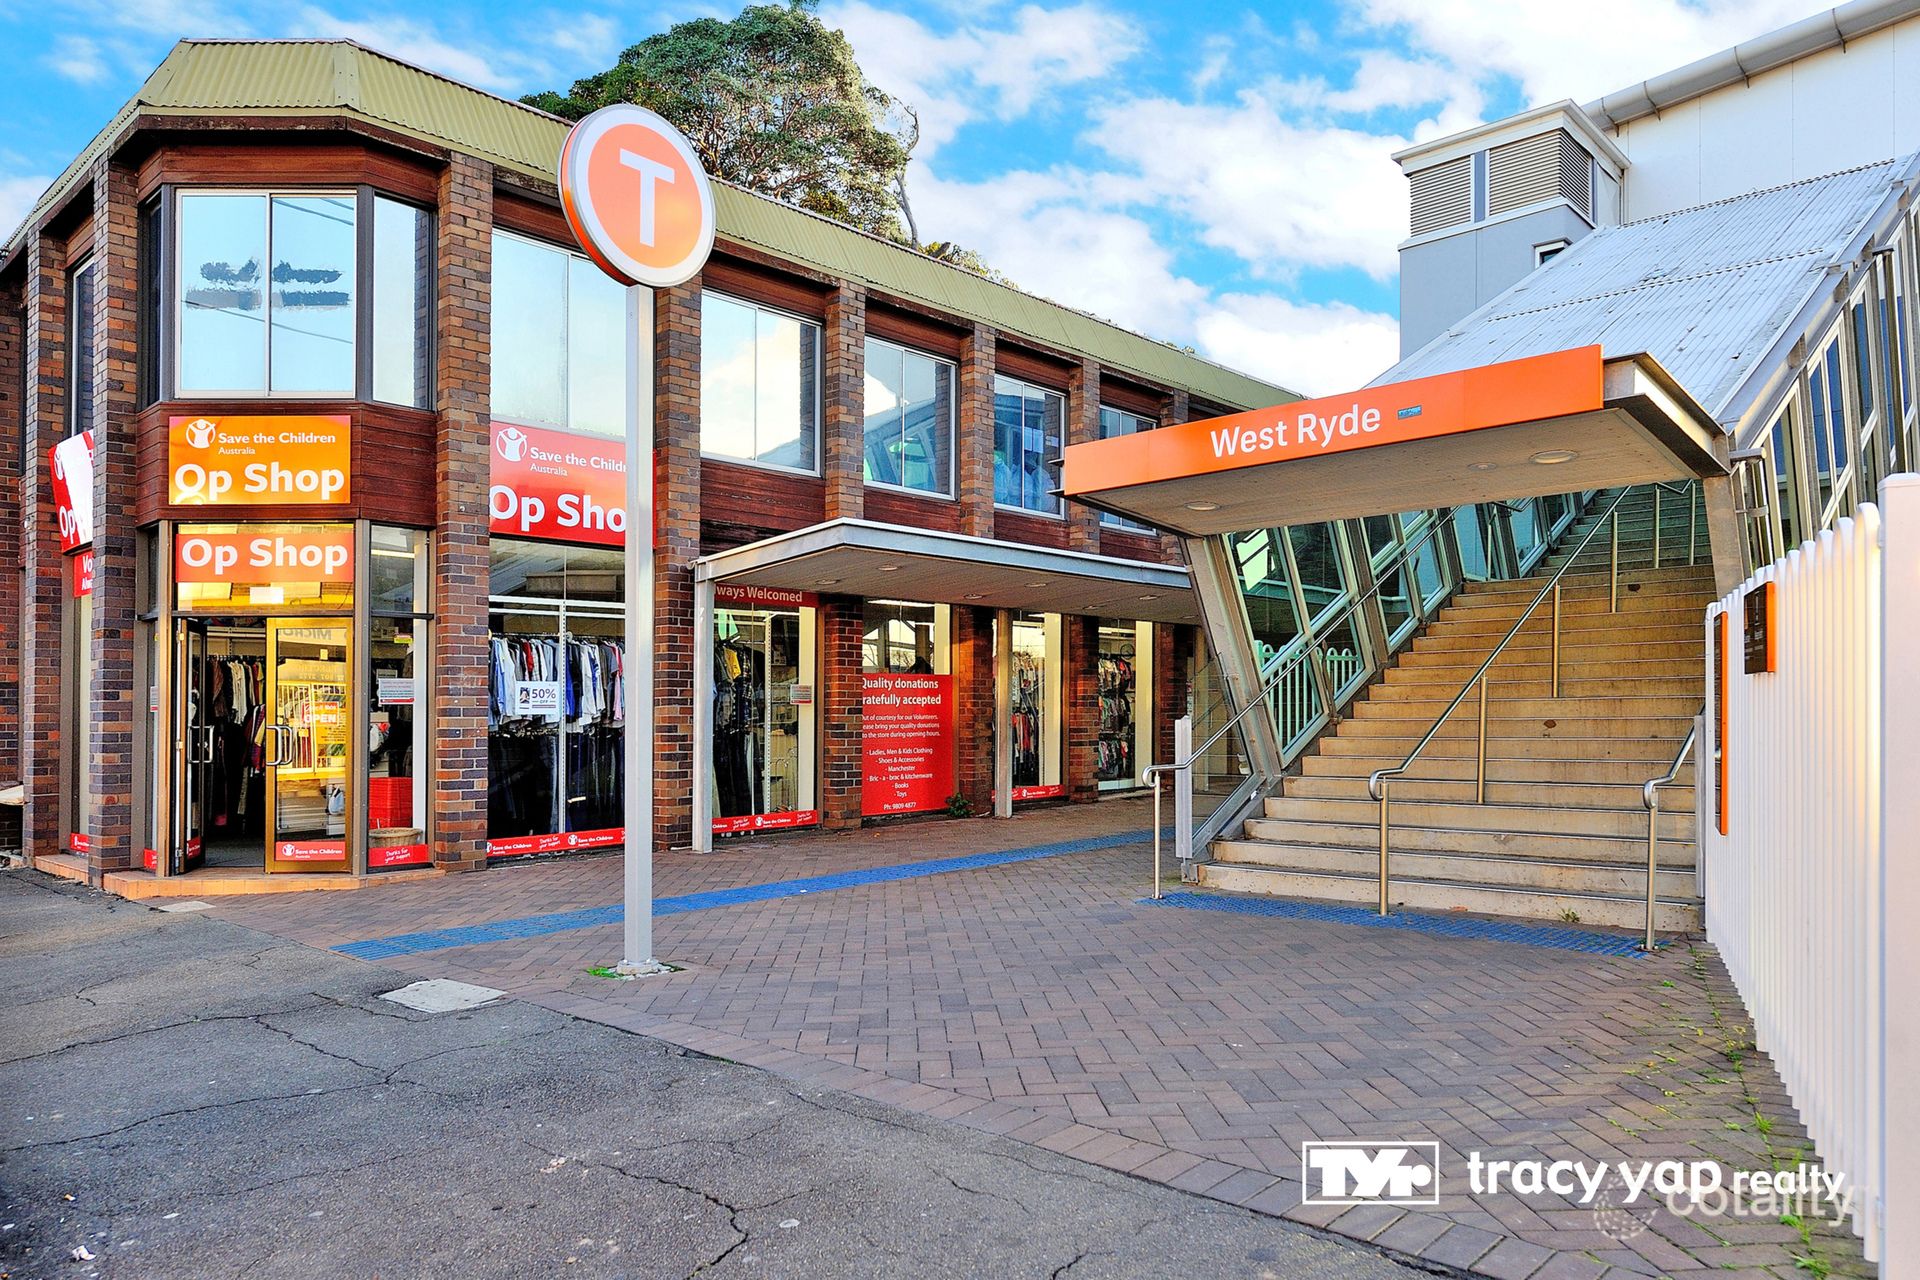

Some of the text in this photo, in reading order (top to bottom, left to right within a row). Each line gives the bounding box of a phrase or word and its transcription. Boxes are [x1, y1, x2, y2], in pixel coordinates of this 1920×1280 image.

[619, 147, 675, 248] T
[1210, 403, 1381, 458] West Ryde
[218, 432, 336, 444] Save the Children
[218, 446, 256, 455] Australia
[530, 446, 562, 463] Save
[565, 453, 587, 467] the
[529, 463, 568, 477] Australia
[175, 461, 345, 500] Op Shop
[489, 485, 626, 533] Op Sho
[59, 505, 76, 545] Op
[182, 537, 348, 575] Op Shop
[716, 586, 803, 602] ways Welcomed
[895, 678, 939, 689] donations
[532, 688, 557, 699] 50%
[862, 693, 942, 707] ratefully accepted
[875, 714, 897, 722] courtesy
[874, 723, 888, 731] bring
[900, 722, 917, 730] quality
[912, 747, 933, 755] Clothing
